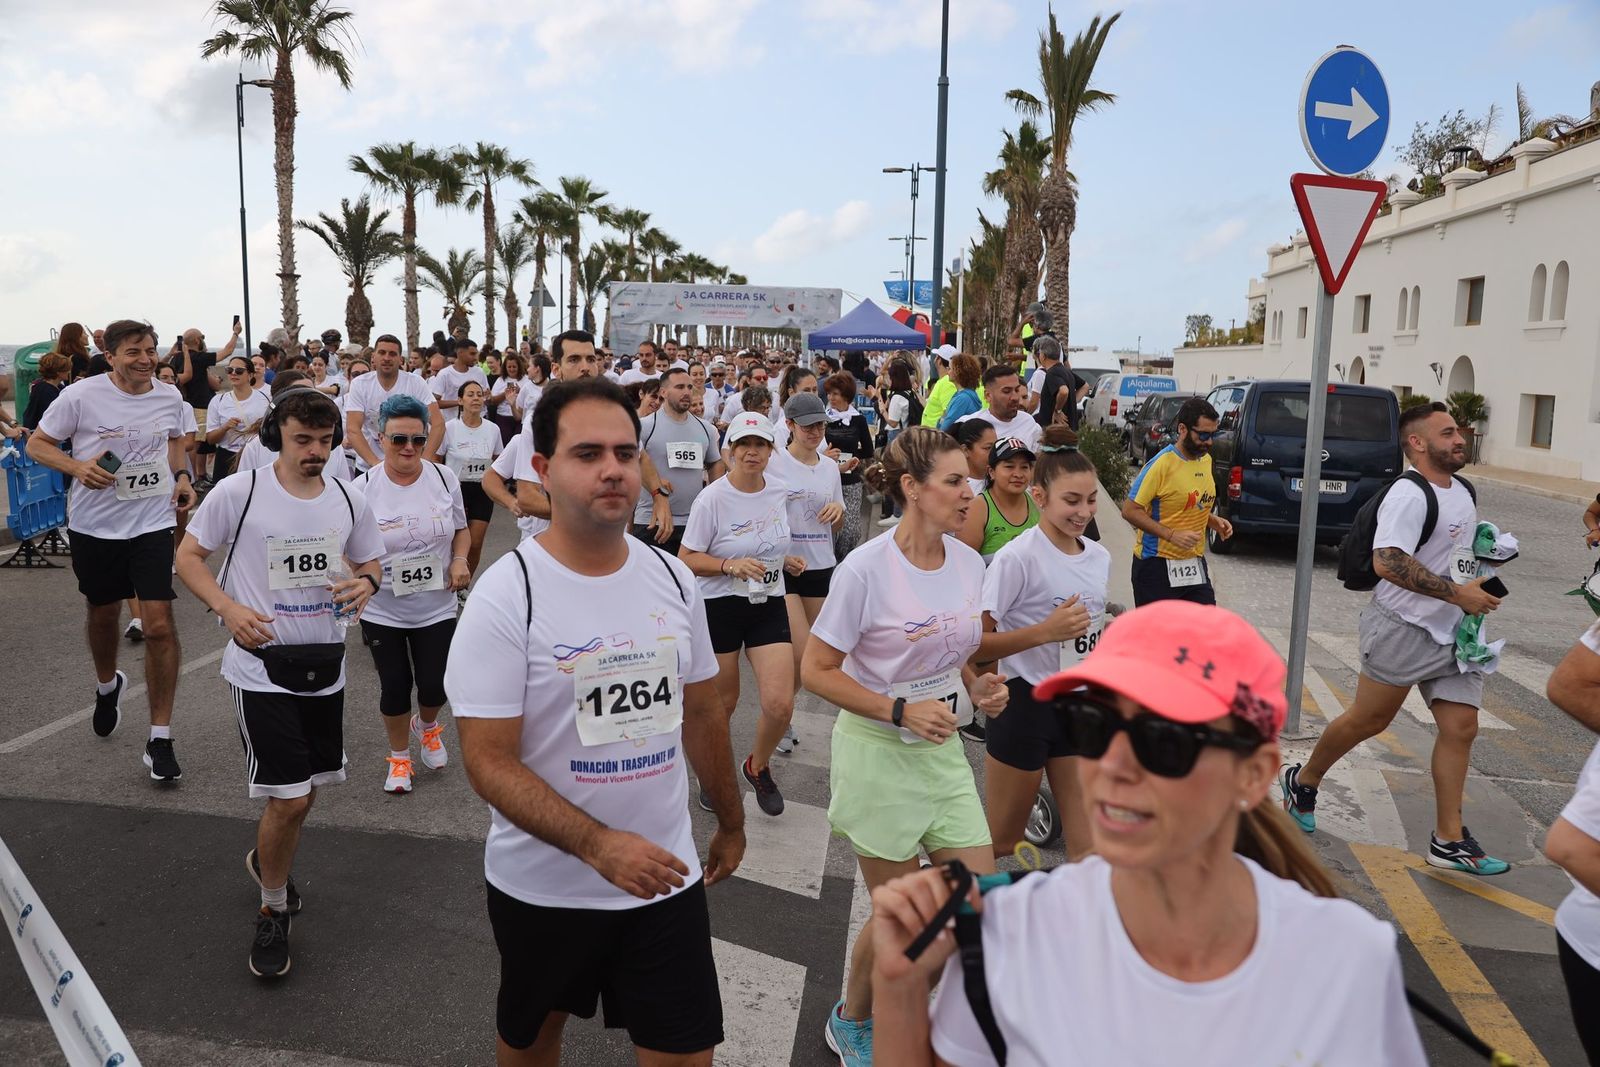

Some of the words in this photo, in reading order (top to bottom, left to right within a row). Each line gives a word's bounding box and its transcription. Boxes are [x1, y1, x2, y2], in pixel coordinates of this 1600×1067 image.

[683, 291, 697, 299] 3A
[700, 291, 750, 301] CARRERA
[753, 293, 767, 302] 5K
[830, 337, 904, 345] info@dorsalchip.es
[675, 450, 696, 461] 565
[467, 464, 485, 472] 114
[126, 472, 160, 489] 743
[1325, 482, 1342, 491] HNR
[283, 553, 328, 573] 188
[401, 566, 433, 583] 543
[763, 569, 779, 584] 08
[1171, 565, 1198, 578] 1123
[598, 658, 607, 666] 3A
[608, 652, 645, 663] CARRERA
[646, 651, 657, 659] 5K
[920, 676, 945, 688] CARRERA
[586, 676, 672, 717] 1264
[570, 759, 618, 773] DONACIÓN
[621, 752, 666, 772] TRASPLANTE
[575, 775, 608, 784] Memorial
[609, 775, 634, 783] Vicente
[635, 768, 661, 780] Granados
